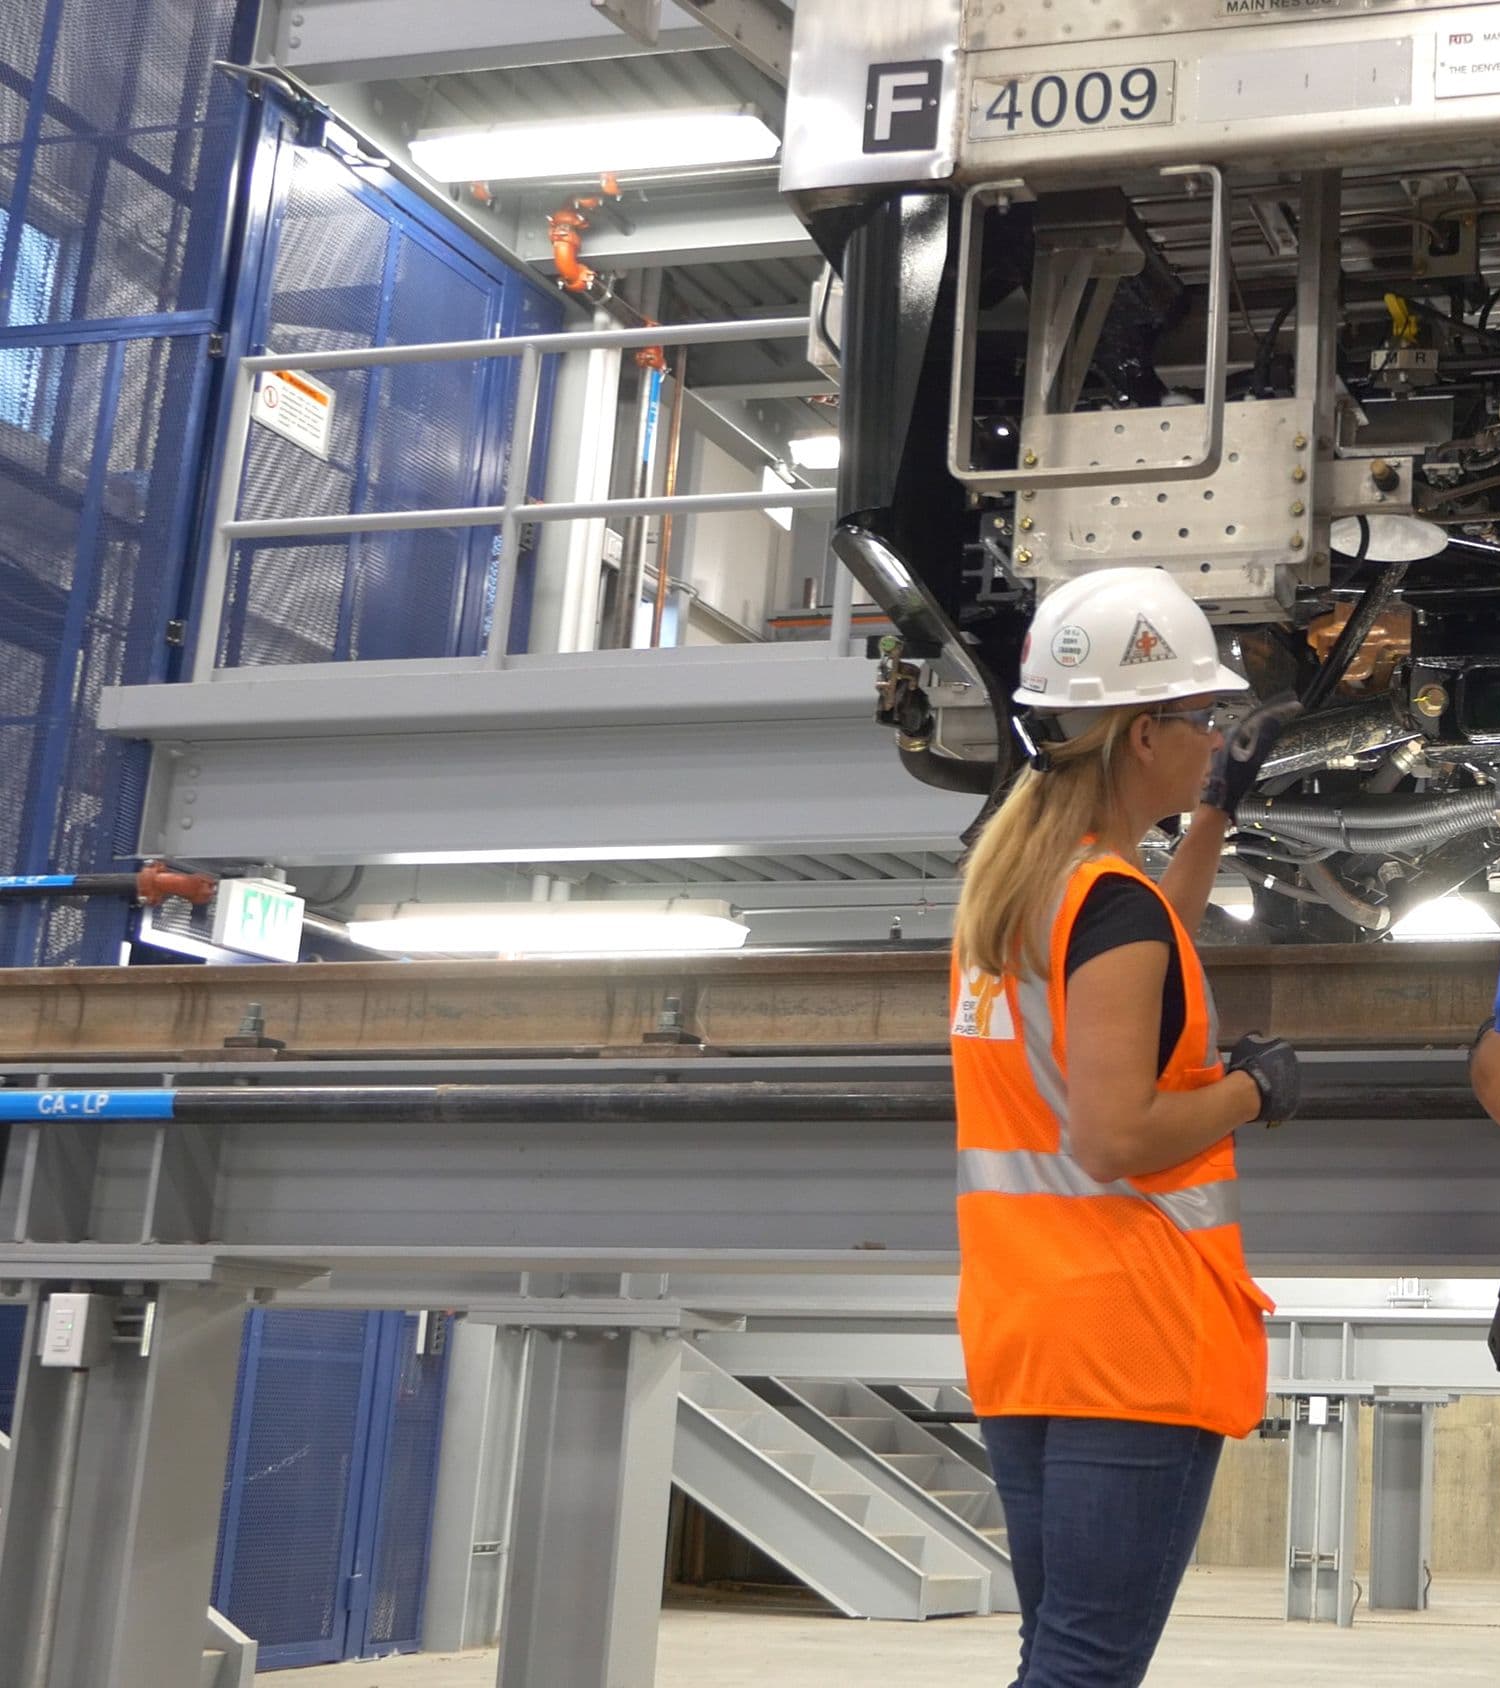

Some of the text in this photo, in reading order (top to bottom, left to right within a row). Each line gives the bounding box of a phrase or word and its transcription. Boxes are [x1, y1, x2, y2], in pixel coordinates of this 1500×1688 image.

[1226, 0, 1264, 13] MAIN
[1270, 0, 1299, 8] RES
[1449, 65, 1466, 74] THE
[874, 72, 928, 140] F
[986, 67, 1157, 130] 4009
